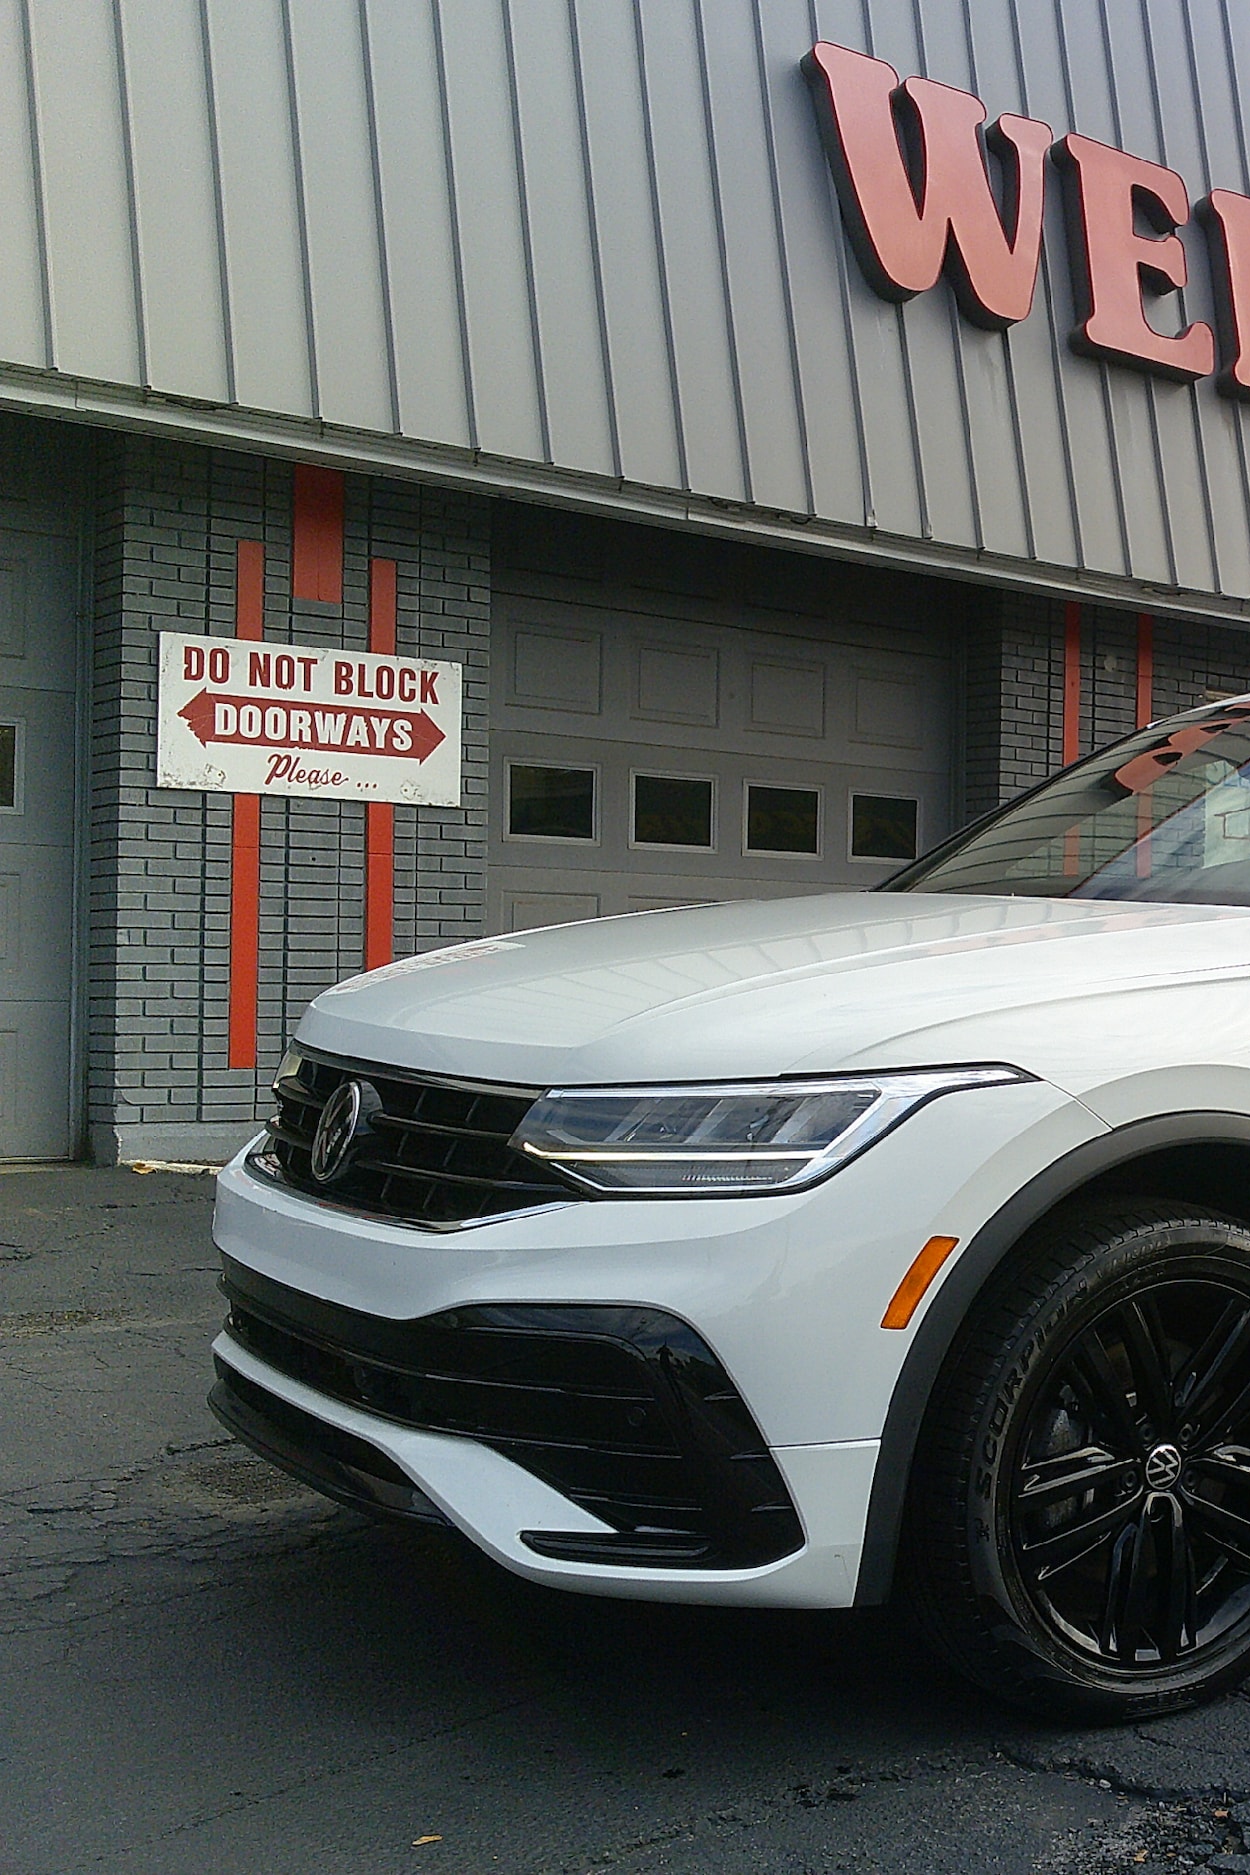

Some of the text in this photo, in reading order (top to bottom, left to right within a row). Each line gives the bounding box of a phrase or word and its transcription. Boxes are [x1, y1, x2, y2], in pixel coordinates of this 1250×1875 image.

[183, 645, 440, 705] DO NOT BLOCK
[214, 702, 414, 751] DOORWAYS
